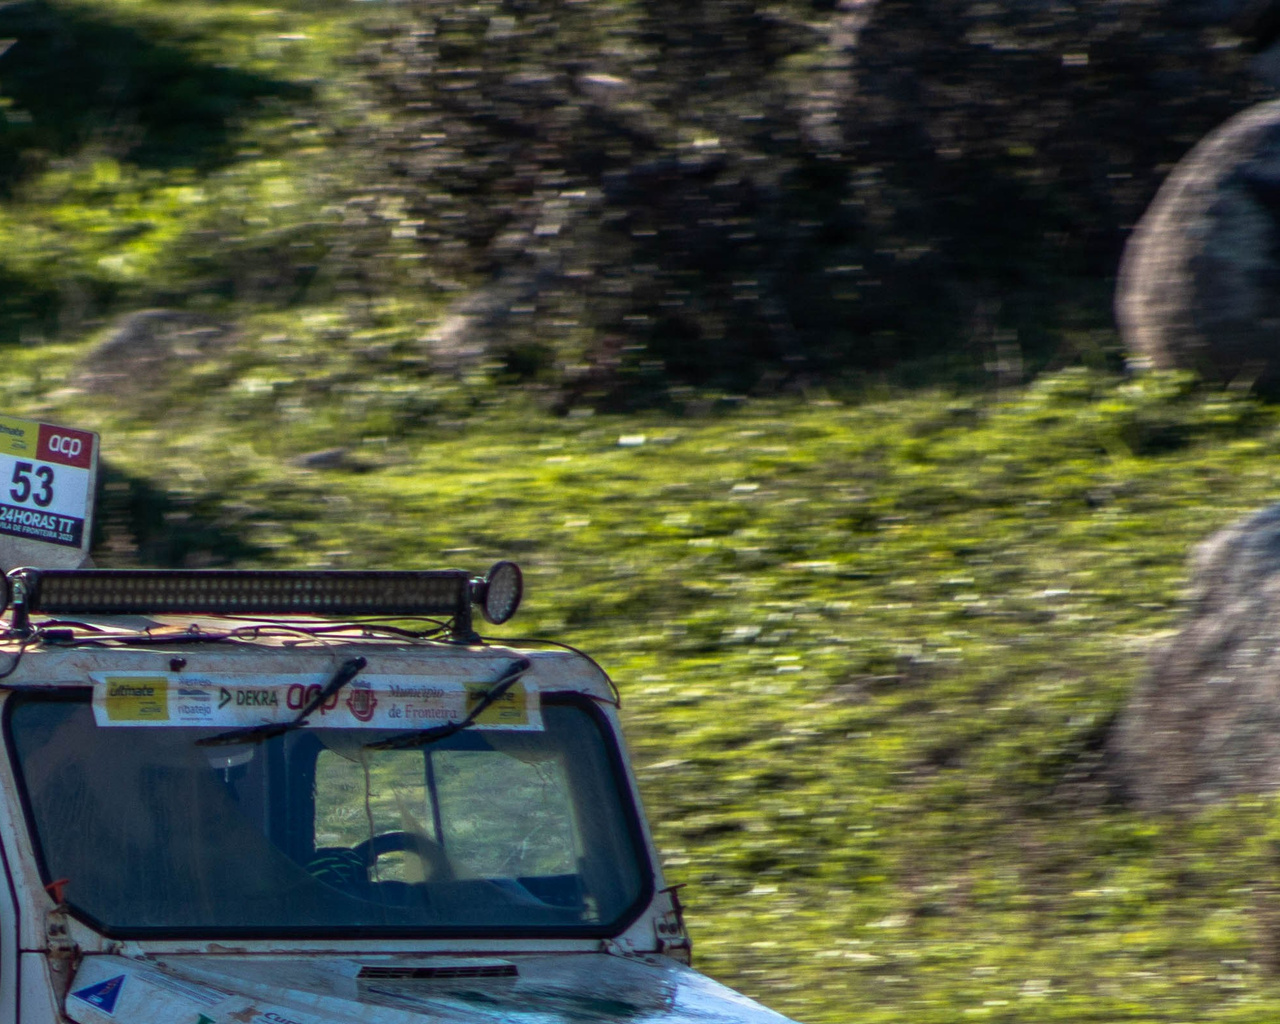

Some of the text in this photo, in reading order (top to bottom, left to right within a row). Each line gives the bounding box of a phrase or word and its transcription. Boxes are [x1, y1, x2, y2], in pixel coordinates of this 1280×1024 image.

[49, 435, 81, 458] acp
[10, 461, 54, 507] 53
[58, 518, 74, 533] TT
[237, 690, 278, 707] DEKRA
[388, 704, 458, 719] de Fronteira
